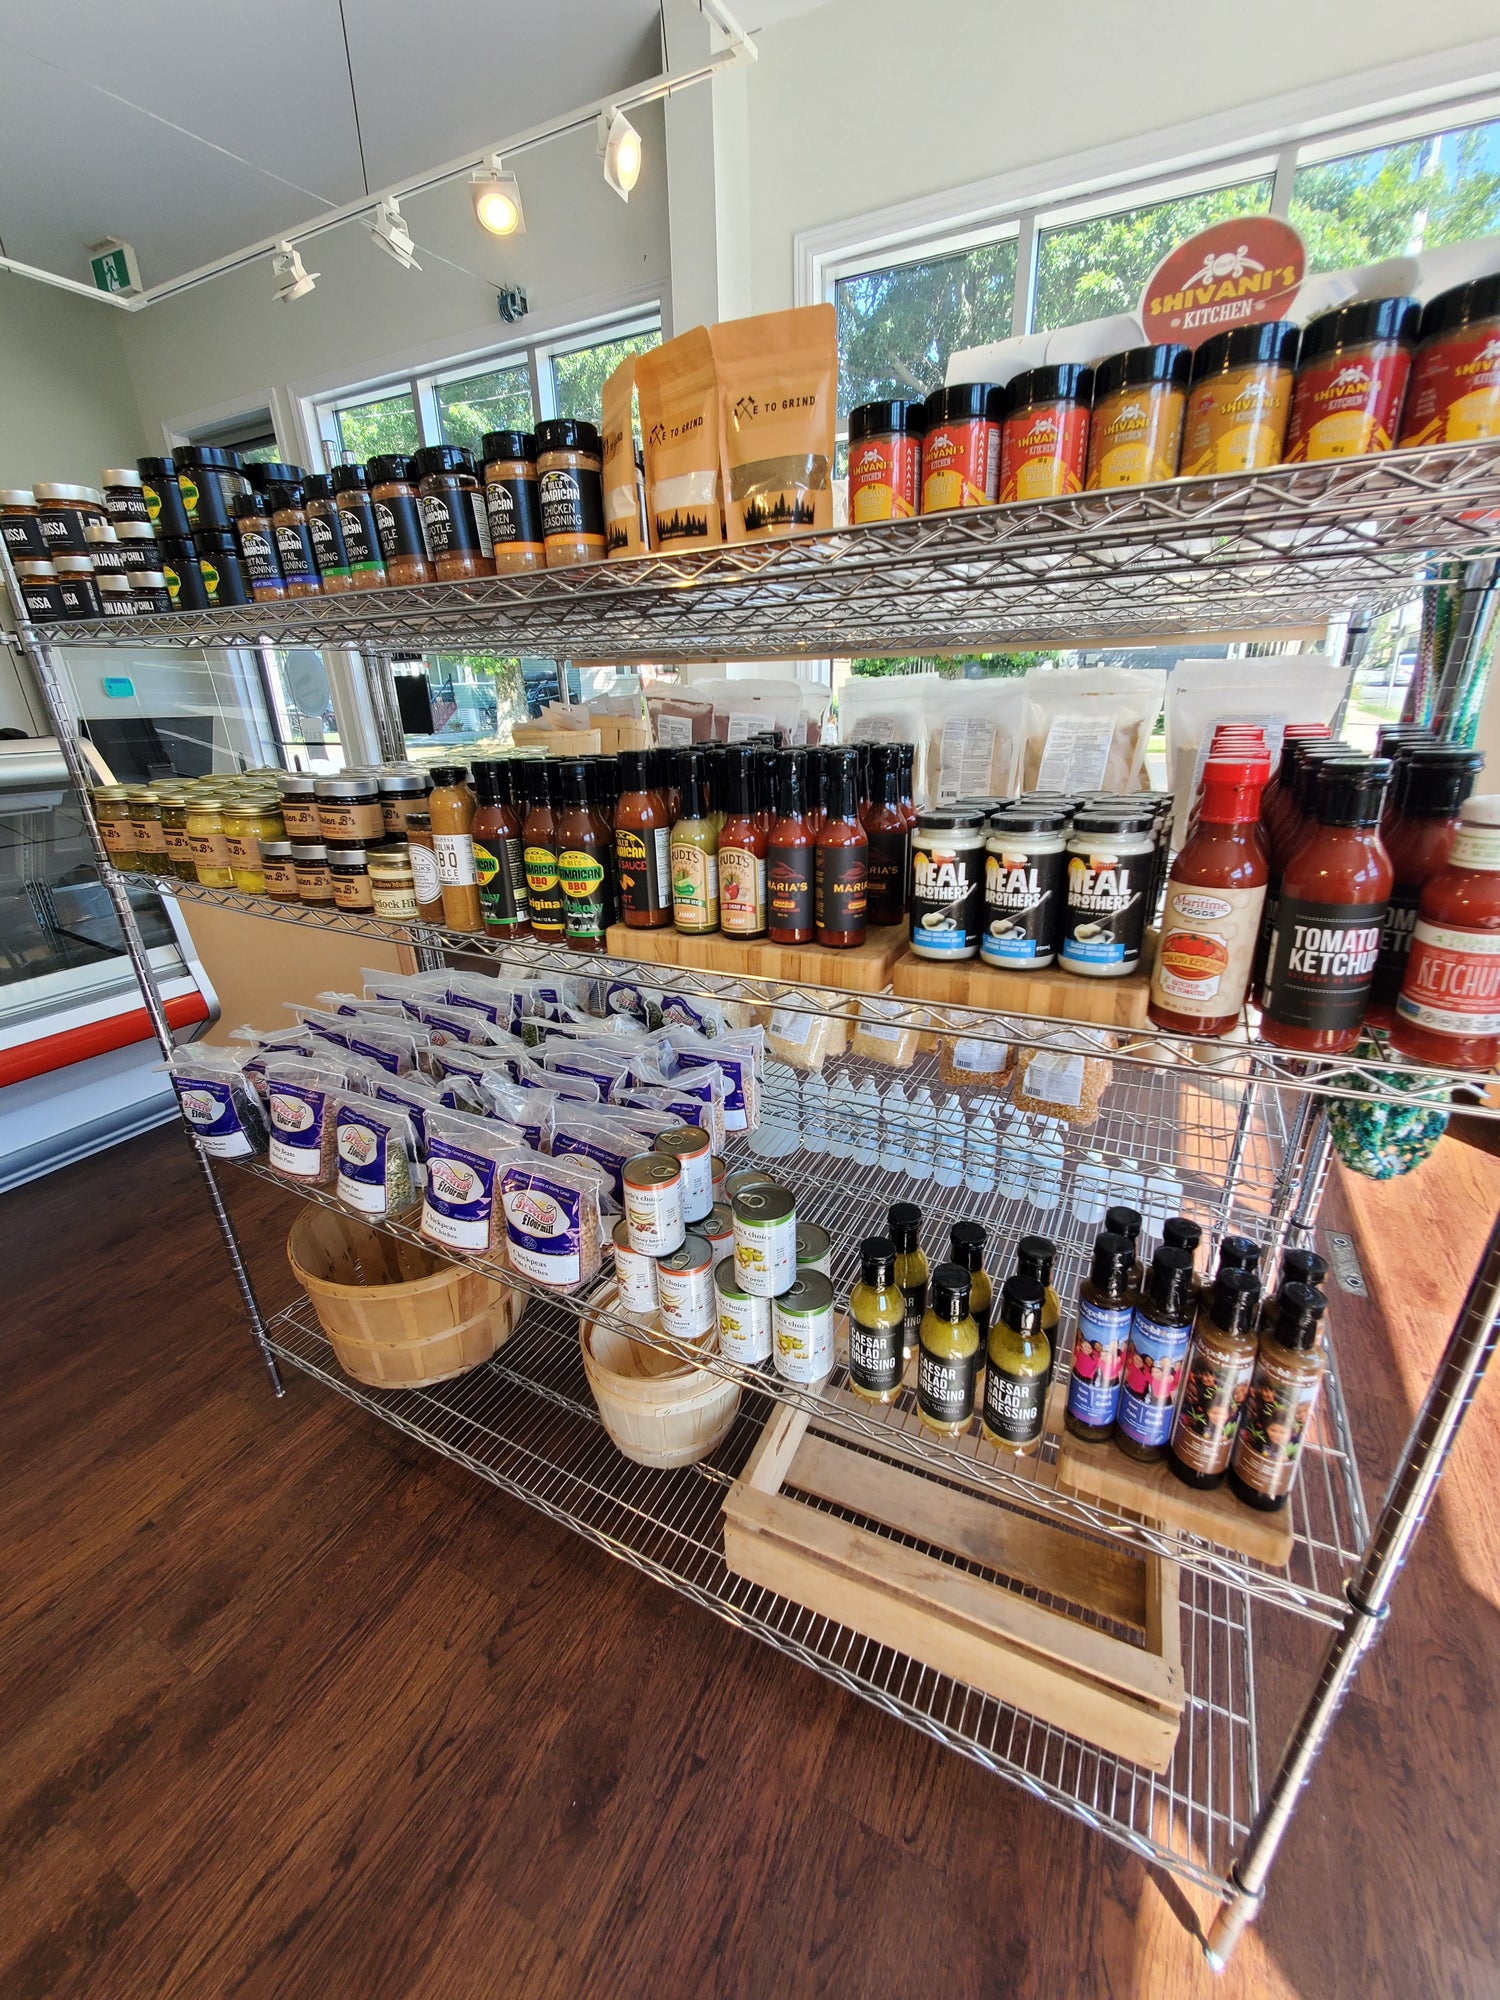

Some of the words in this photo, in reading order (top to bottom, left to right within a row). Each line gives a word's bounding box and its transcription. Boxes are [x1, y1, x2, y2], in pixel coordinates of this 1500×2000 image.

[1150, 265, 1296, 316] SHIVANI'S
[1182, 298, 1253, 330] KITCHEN
[765, 403, 777, 413] TO
[781, 395, 816, 409] GRIND
[670, 429, 679, 438] TO
[682, 416, 703, 434] GRIND
[1103, 417, 1150, 437] SHIVANI
[127, 501, 147, 513] CHIL
[543, 502, 576, 516] CHICKEN
[543, 514, 583, 529] SEASONING
[298, 812, 315, 823] B's
[338, 815, 356, 827] B's
[437, 851, 458, 869] BQ
[621, 860, 647, 871] SAUCE
[274, 872, 290, 882] B's
[439, 868, 459, 877] AUCE
[869, 866, 898, 875] RIA'S
[914, 862, 970, 887] NEAL
[313, 876, 331, 888] B's
[530, 876, 548, 886] BBQ
[567, 881, 587, 891] BBQ
[985, 867, 1042, 894] NEAL
[1069, 868, 1132, 896] NEAL
[343, 885, 359, 896] B's
[914, 883, 969, 901] BROTHERS
[985, 889, 1041, 908] BROTHERS
[375, 898, 400, 909] dock
[402, 898, 417, 908] Hil
[1067, 892, 1131, 910] BROTHERS
[1175, 894, 1228, 911] Maritime
[1181, 906, 1216, 917] FOODS
[1294, 925, 1379, 952] TOMATO
[1288, 948, 1379, 976] KETCHUP
[436, 1180, 456, 1196] flour
[427, 1211, 457, 1232] Chickpeas
[521, 1214, 541, 1229] flour
[540, 1224, 554, 1235] mill
[512, 1248, 547, 1269] Chickpeas
[666, 1279, 688, 1288] choice
[725, 1301, 748, 1312] choice
[851, 1327, 887, 1350] CAESAR
[851, 1338, 880, 1360] SALAD
[851, 1348, 896, 1371] DRESSING
[988, 1369, 1030, 1398] CAESAR
[988, 1382, 1020, 1408] SALAD
[987, 1392, 1038, 1421] DRESSING
